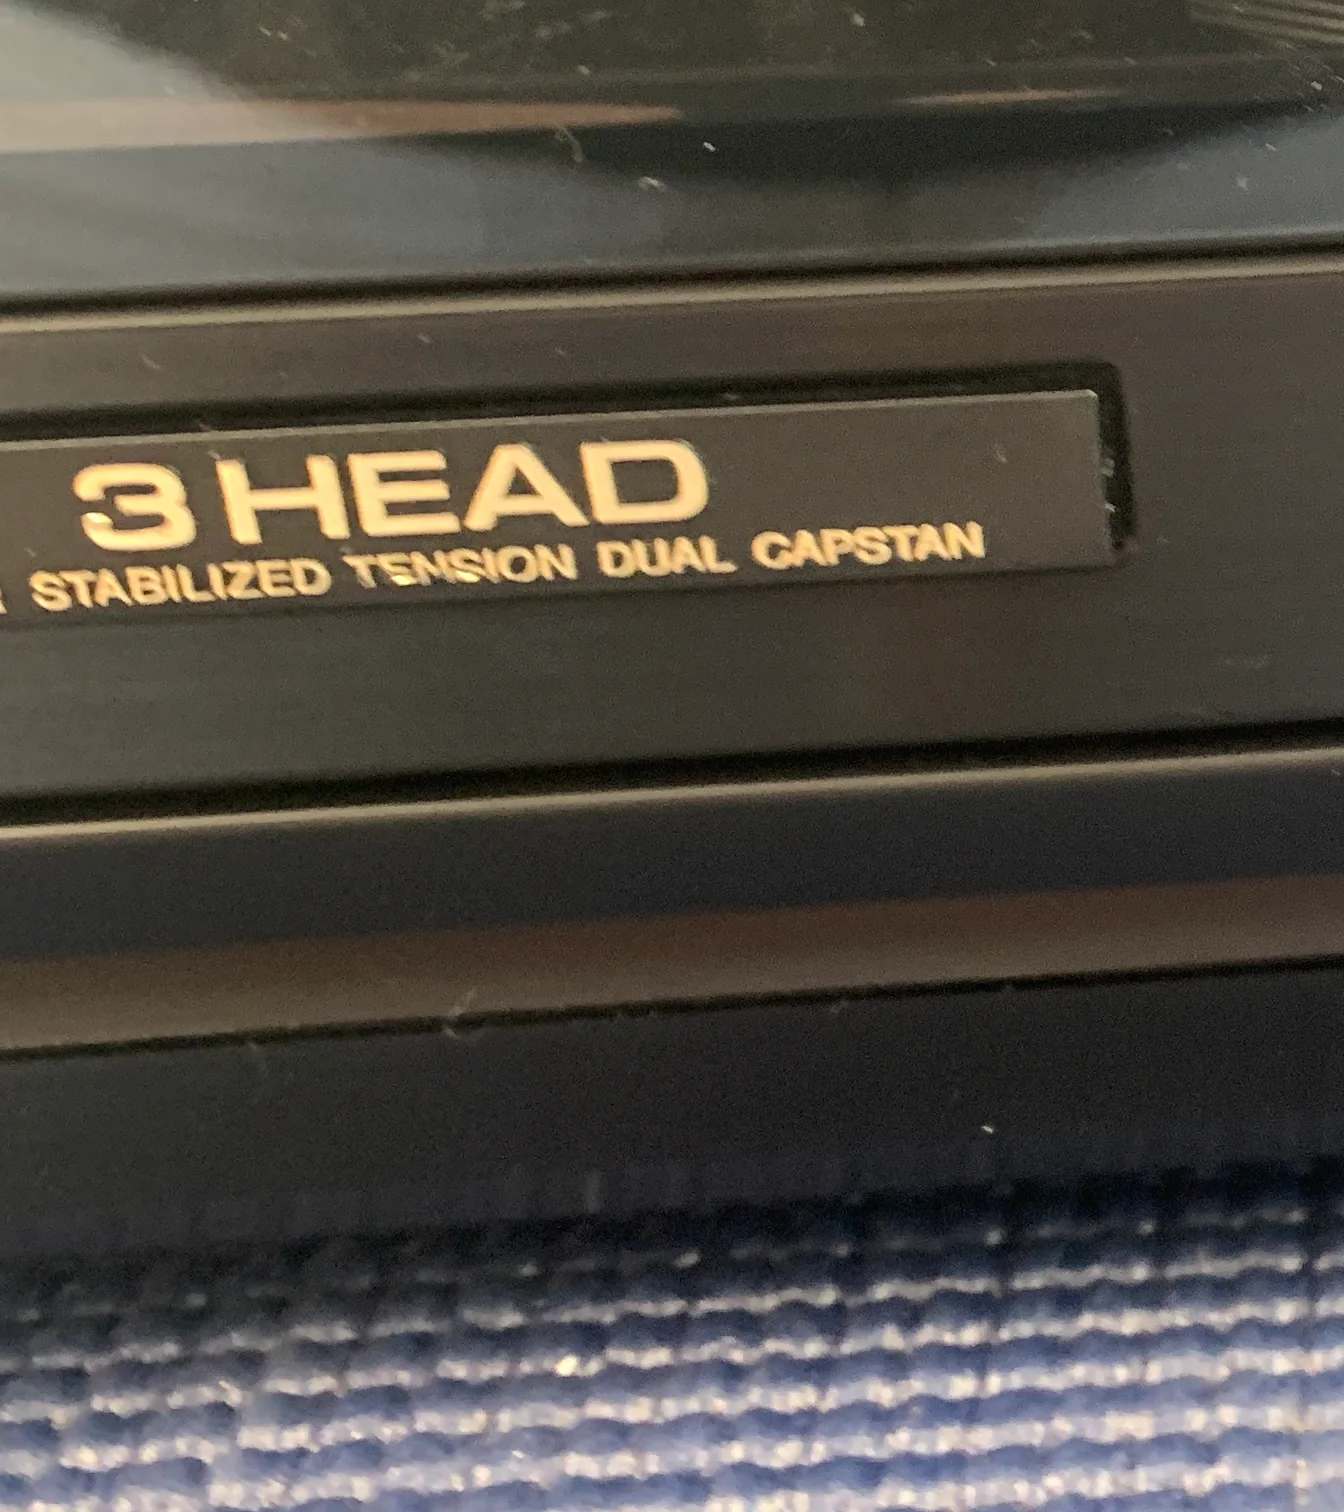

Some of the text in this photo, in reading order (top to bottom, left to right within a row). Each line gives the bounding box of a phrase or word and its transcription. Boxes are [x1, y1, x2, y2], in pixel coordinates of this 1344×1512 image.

[72, 440, 710, 551] 3 HEAD
[29, 557, 332, 612] STABILIZED
[343, 543, 578, 588] TENSION
[596, 535, 737, 578] DUAL
[751, 521, 986, 570] CAPSTAN
